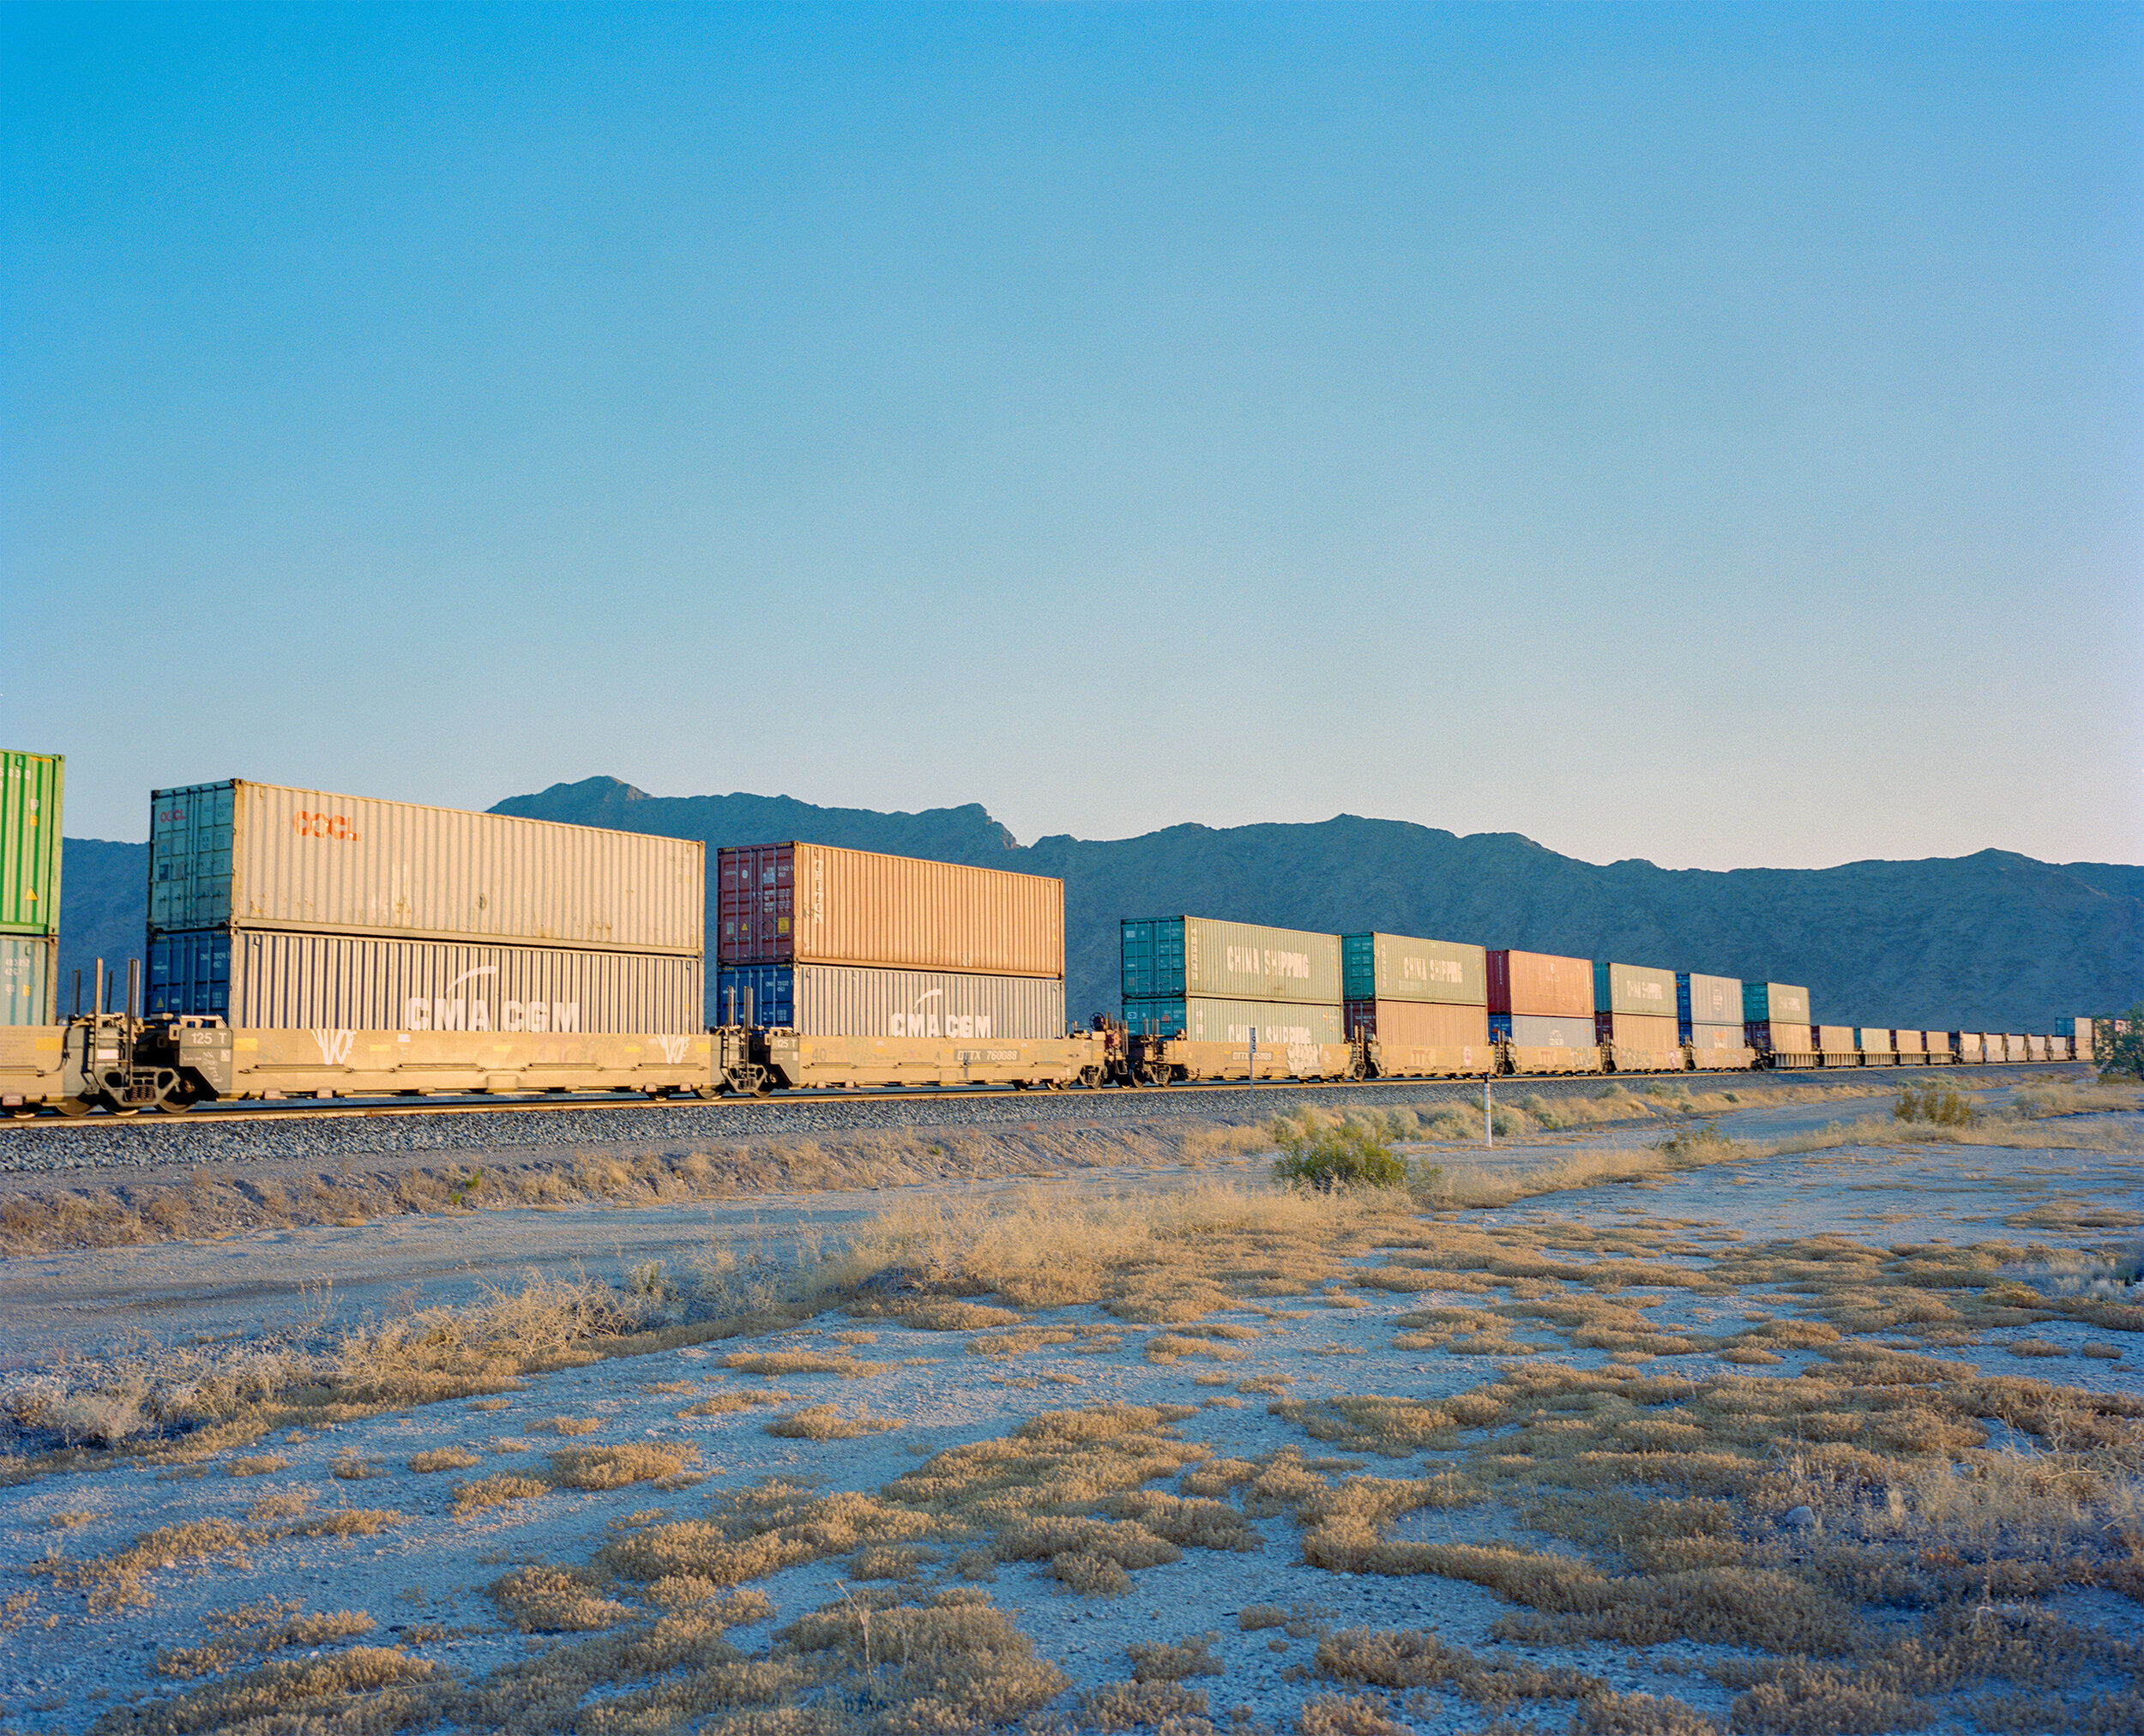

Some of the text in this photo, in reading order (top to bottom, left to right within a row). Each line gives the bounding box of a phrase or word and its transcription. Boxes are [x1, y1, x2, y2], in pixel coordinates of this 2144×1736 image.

[292, 810, 361, 841] OOCL
[1227, 945, 1259, 974] CHINA
[405, 997, 580, 1033] CMA CGM
[891, 1013, 991, 1038] CMA CGM
[191, 1032, 227, 1045] 125 T
[776, 1039, 797, 1048] 125 T
[811, 1048, 827, 1061] 40
[957, 1050, 981, 1061] DTTX
